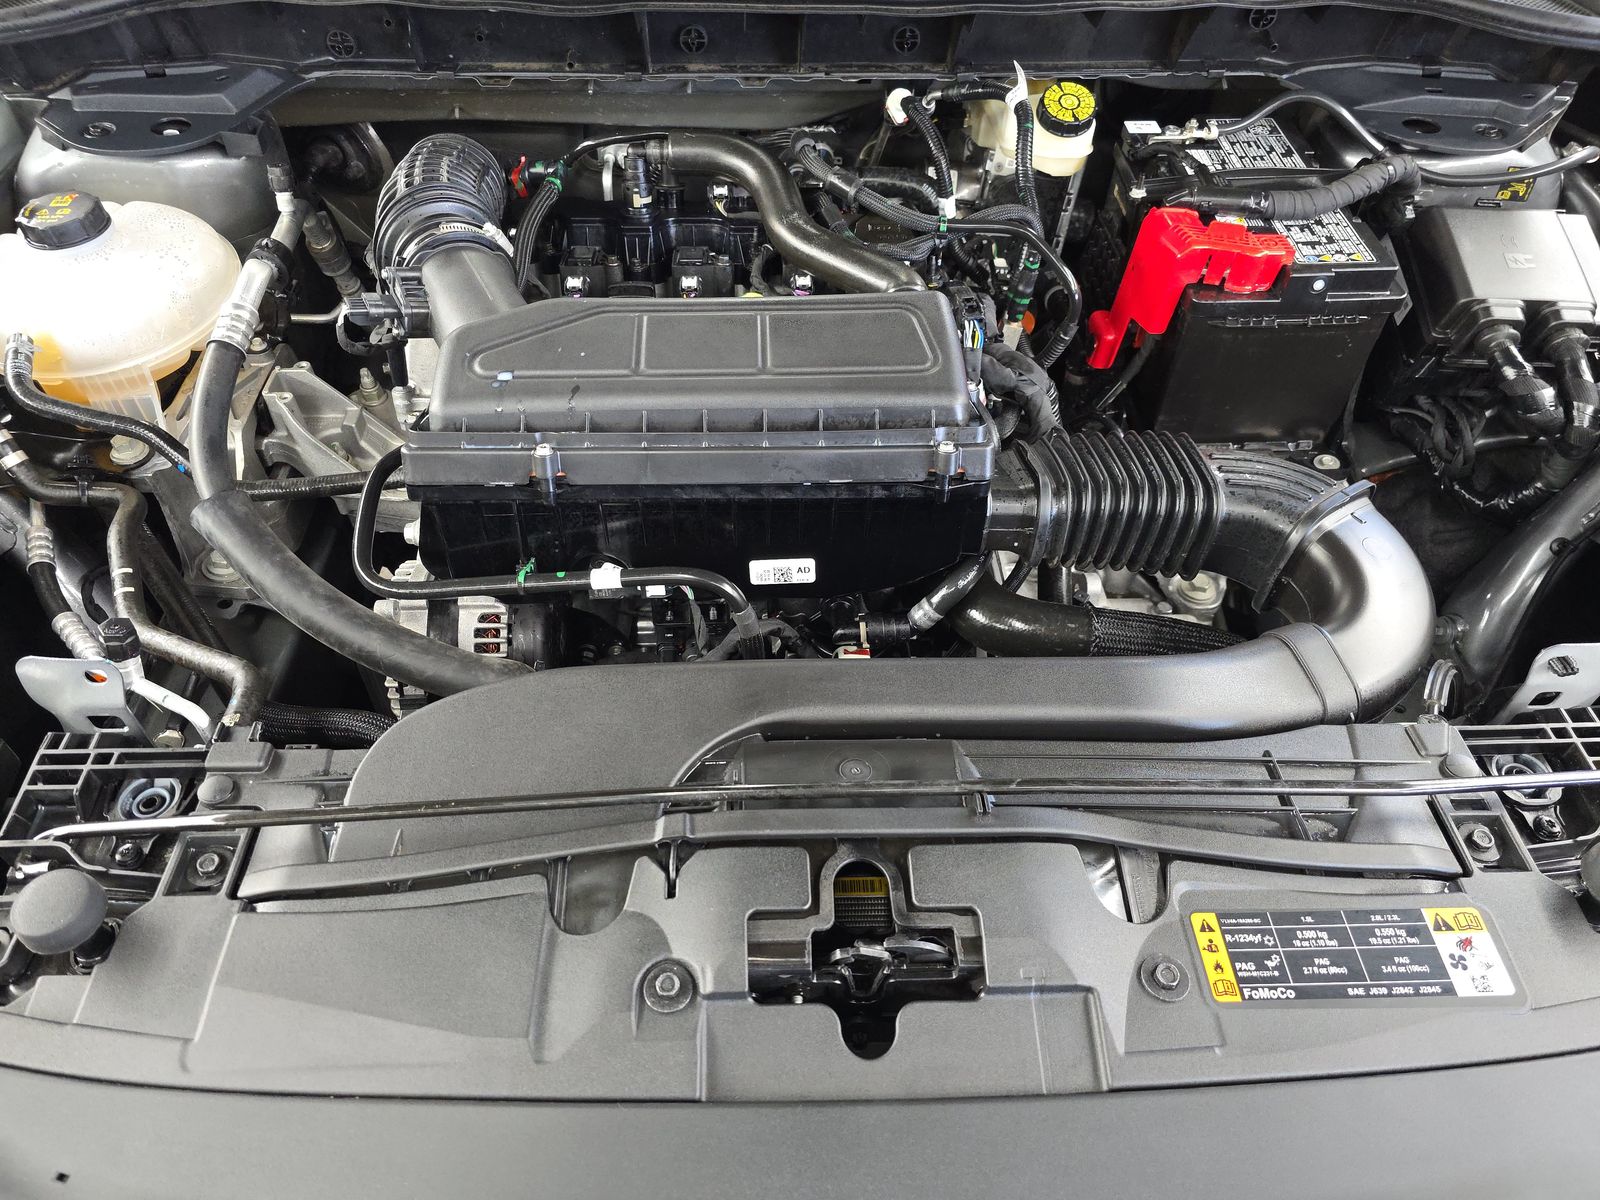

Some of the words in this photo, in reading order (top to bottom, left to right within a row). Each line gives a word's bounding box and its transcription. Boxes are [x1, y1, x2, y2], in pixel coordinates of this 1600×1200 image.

[797, 566, 811, 574] AD
[1296, 930, 1317, 939] 0.500
[1317, 930, 1328, 940] kg
[1375, 928, 1395, 936] 0.550
[1395, 928, 1407, 937] kg
[1224, 934, 1262, 944] R-1234yf
[1314, 957, 1330, 966] PAG
[1235, 962, 1256, 971] PAG
[1381, 965, 1392, 973] 3.4
[1243, 987, 1296, 1000] FoMoCo
[1347, 987, 1366, 996] SAE
